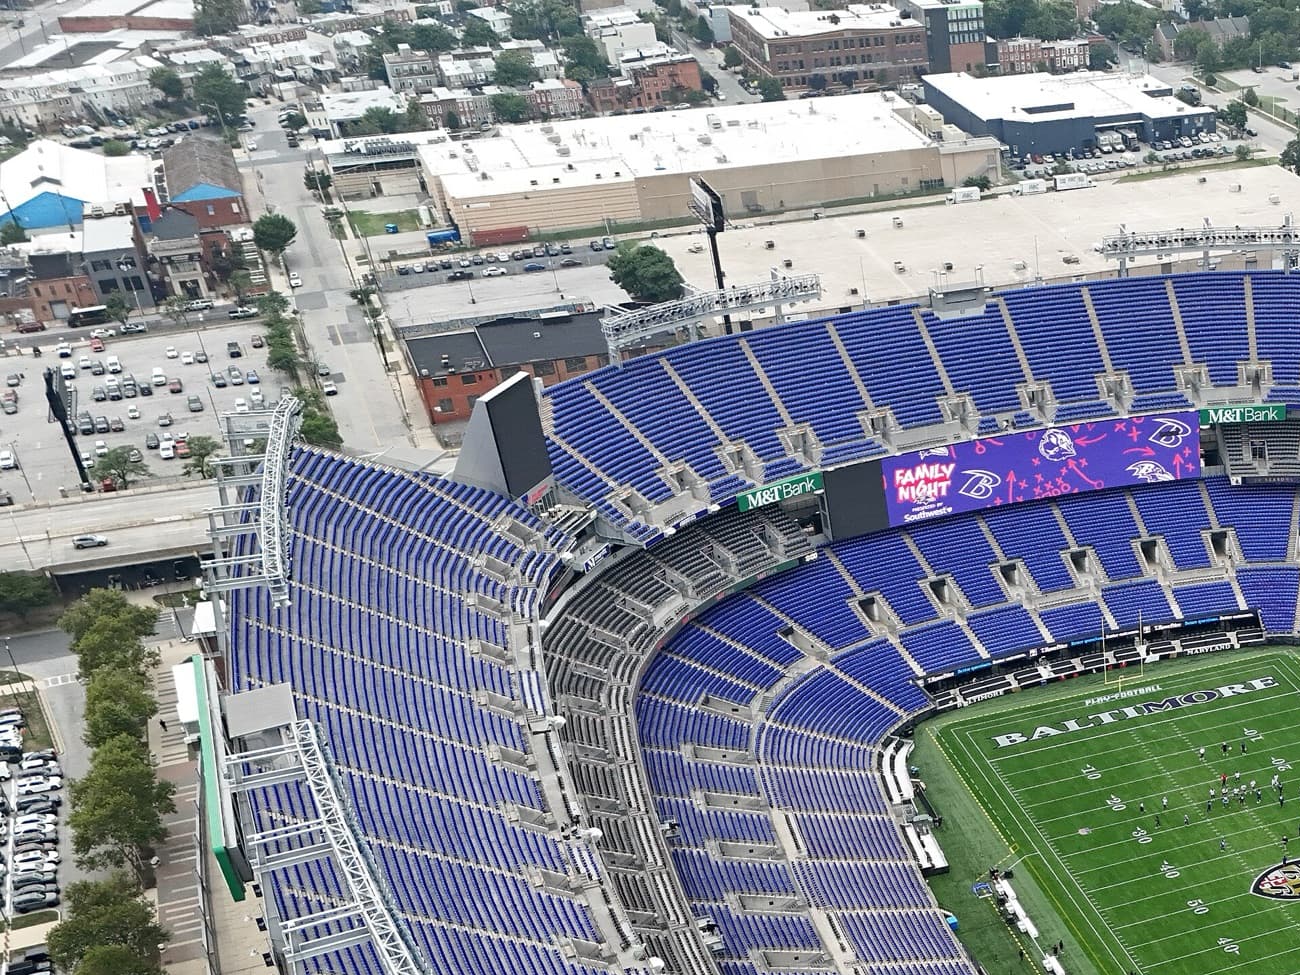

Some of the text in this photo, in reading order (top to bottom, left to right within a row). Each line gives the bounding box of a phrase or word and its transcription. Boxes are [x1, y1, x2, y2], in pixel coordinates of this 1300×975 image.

[1208, 406, 1278, 424] M&T Bank
[895, 463, 956, 485] FAMILY
[746, 477, 817, 509] M&T Bank
[896, 480, 952, 501] NIGHT
[904, 507, 947, 522] Southwest
[1186, 644, 1231, 655] MARYLAND
[1084, 684, 1163, 706] PLAY FOOTBALL
[992, 676, 1280, 748] BALTIMORE
[1244, 728, 1264, 742] 10
[1272, 757, 1293, 772] 20
[1081, 766, 1102, 780] 10
[1106, 796, 1127, 811] 20
[1132, 829, 1152, 844] 30
[1187, 899, 1209, 915] 50
